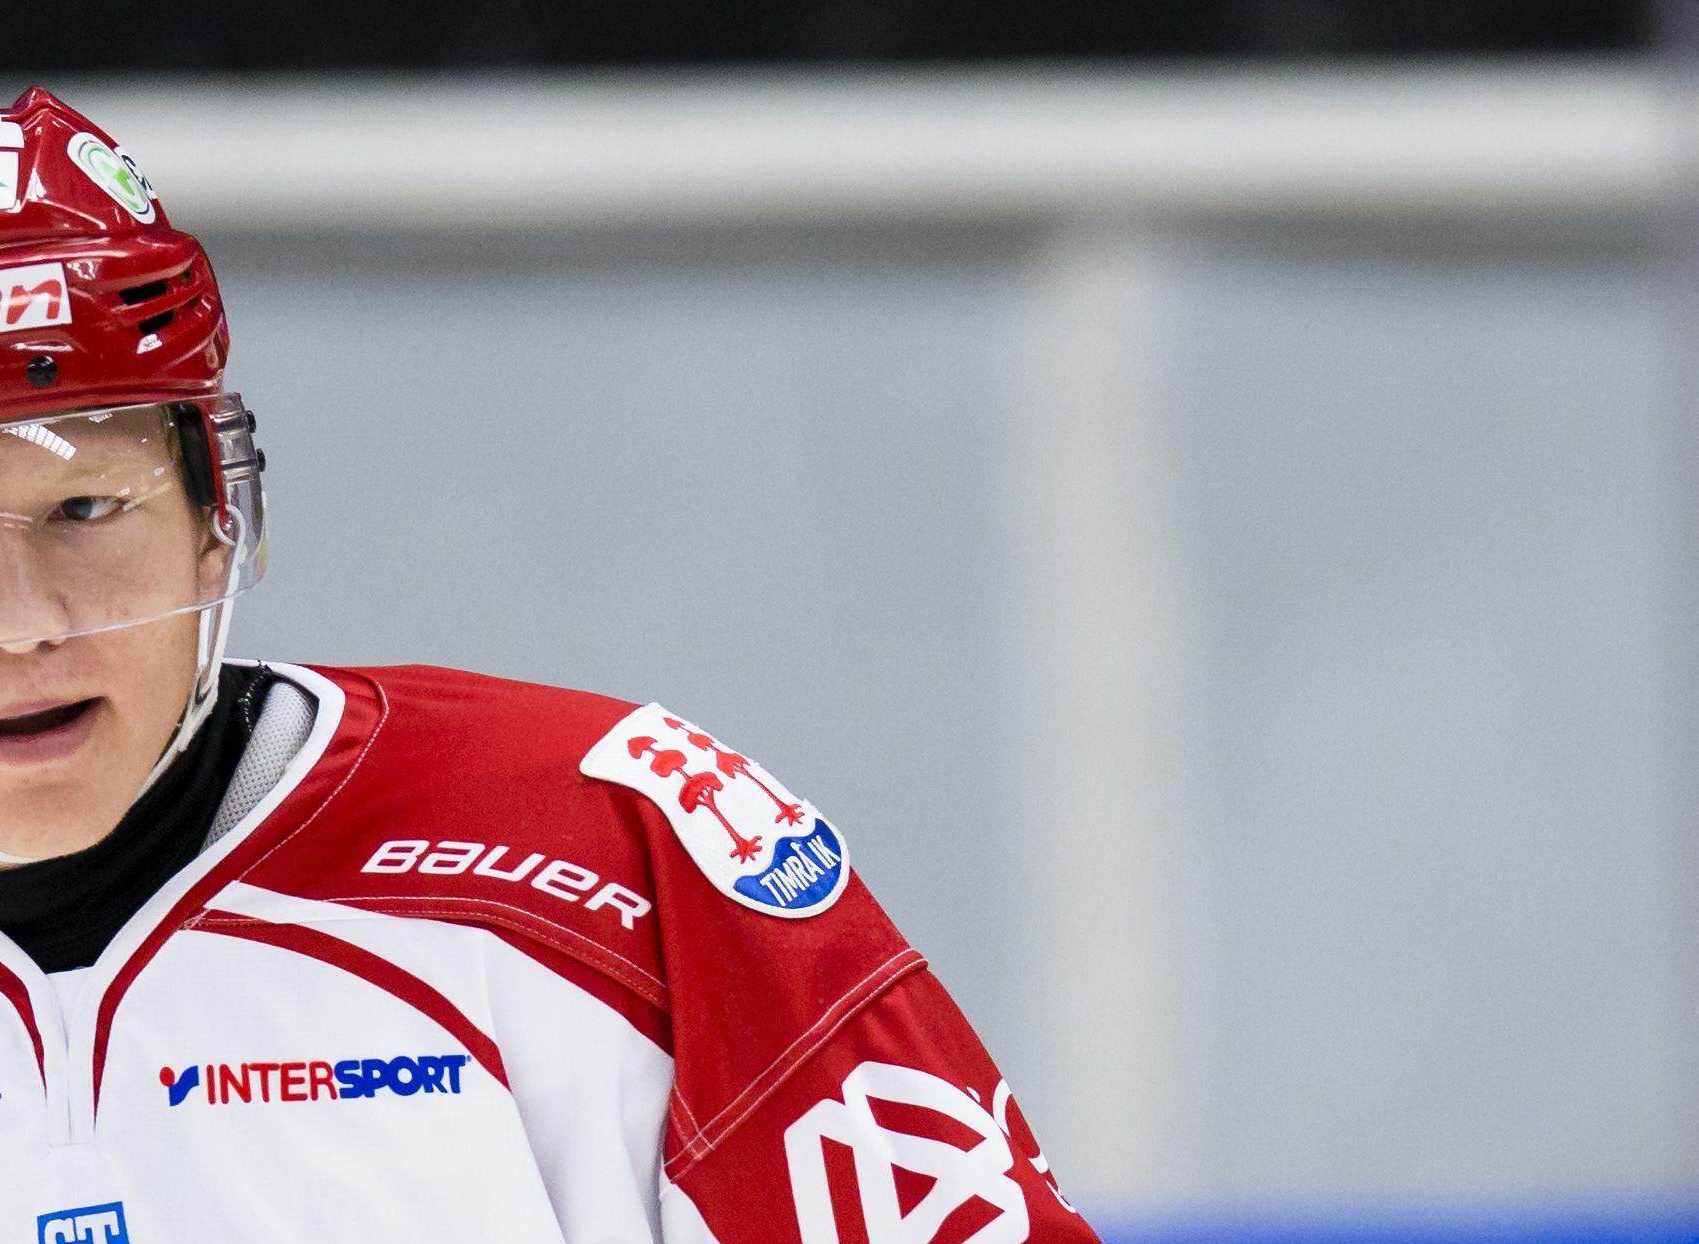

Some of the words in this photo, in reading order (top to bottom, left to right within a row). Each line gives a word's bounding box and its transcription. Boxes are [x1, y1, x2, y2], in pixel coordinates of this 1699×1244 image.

[759, 841, 826, 908] TIMRÅ
[806, 834, 842, 870] IK
[205, 1053, 470, 1106] INTERSPORT
